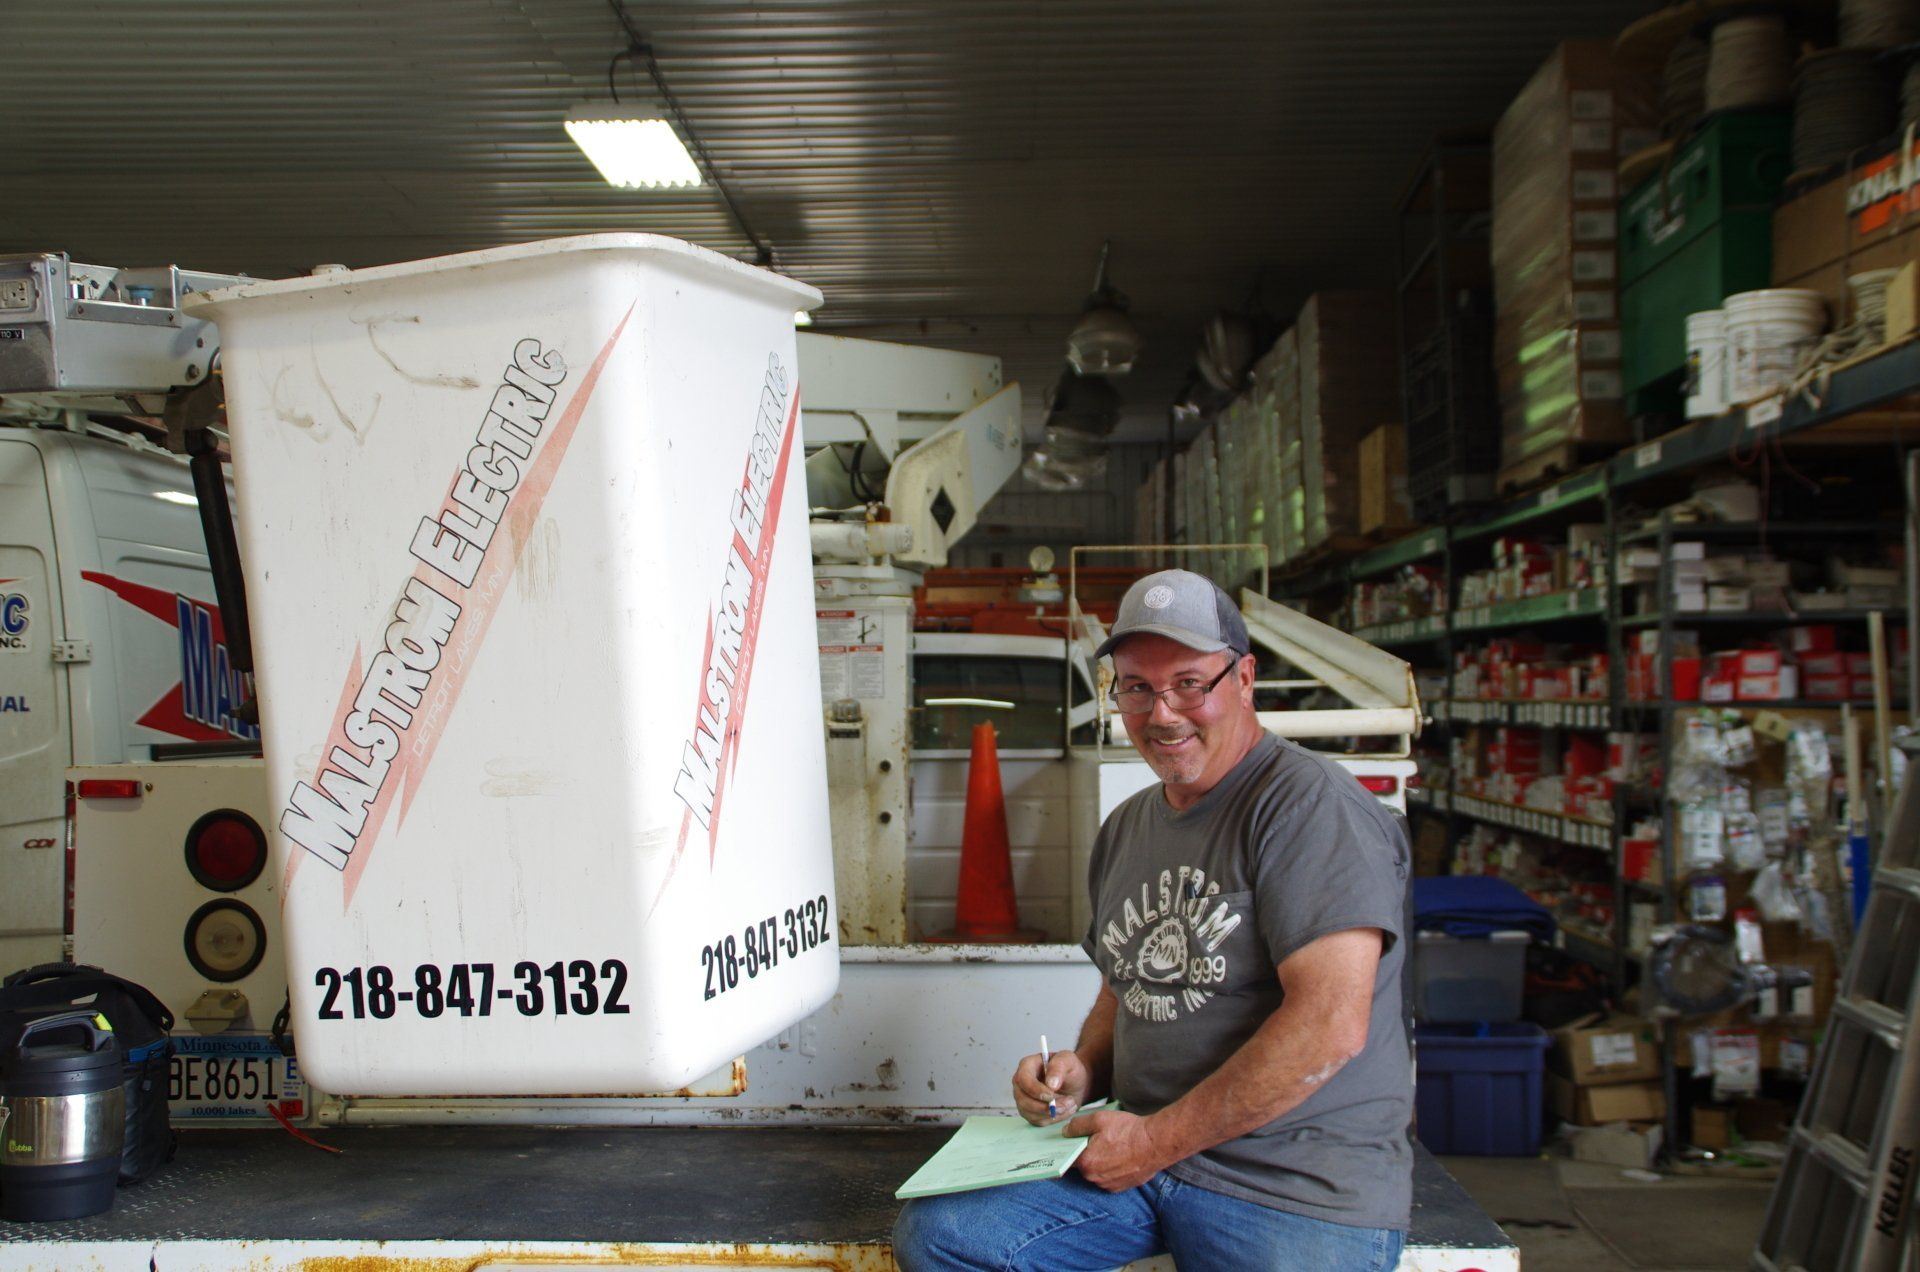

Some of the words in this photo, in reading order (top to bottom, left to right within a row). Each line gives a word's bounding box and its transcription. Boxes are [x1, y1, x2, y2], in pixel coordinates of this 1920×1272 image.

[279, 574, 463, 872] MALSTROM
[409, 337, 568, 589] ELECTRIC
[674, 543, 755, 831] MALSTROM
[729, 351, 790, 562] ELECTRIC
[176, 592, 262, 741] MAL
[412, 675, 454, 757] DETROIT
[480, 565, 504, 604] MN
[701, 894, 831, 1002] 218-847-3132
[1102, 865, 1242, 958] MALSTROM
[1153, 943, 1178, 963] MN
[315, 959, 631, 1020] 218-847-3132
[1124, 979, 1178, 1022] ELECTRIC
[1189, 954, 1226, 985] 1999
[228, 1105, 257, 1115] lakes
[1875, 1146, 1914, 1239] KELLER
